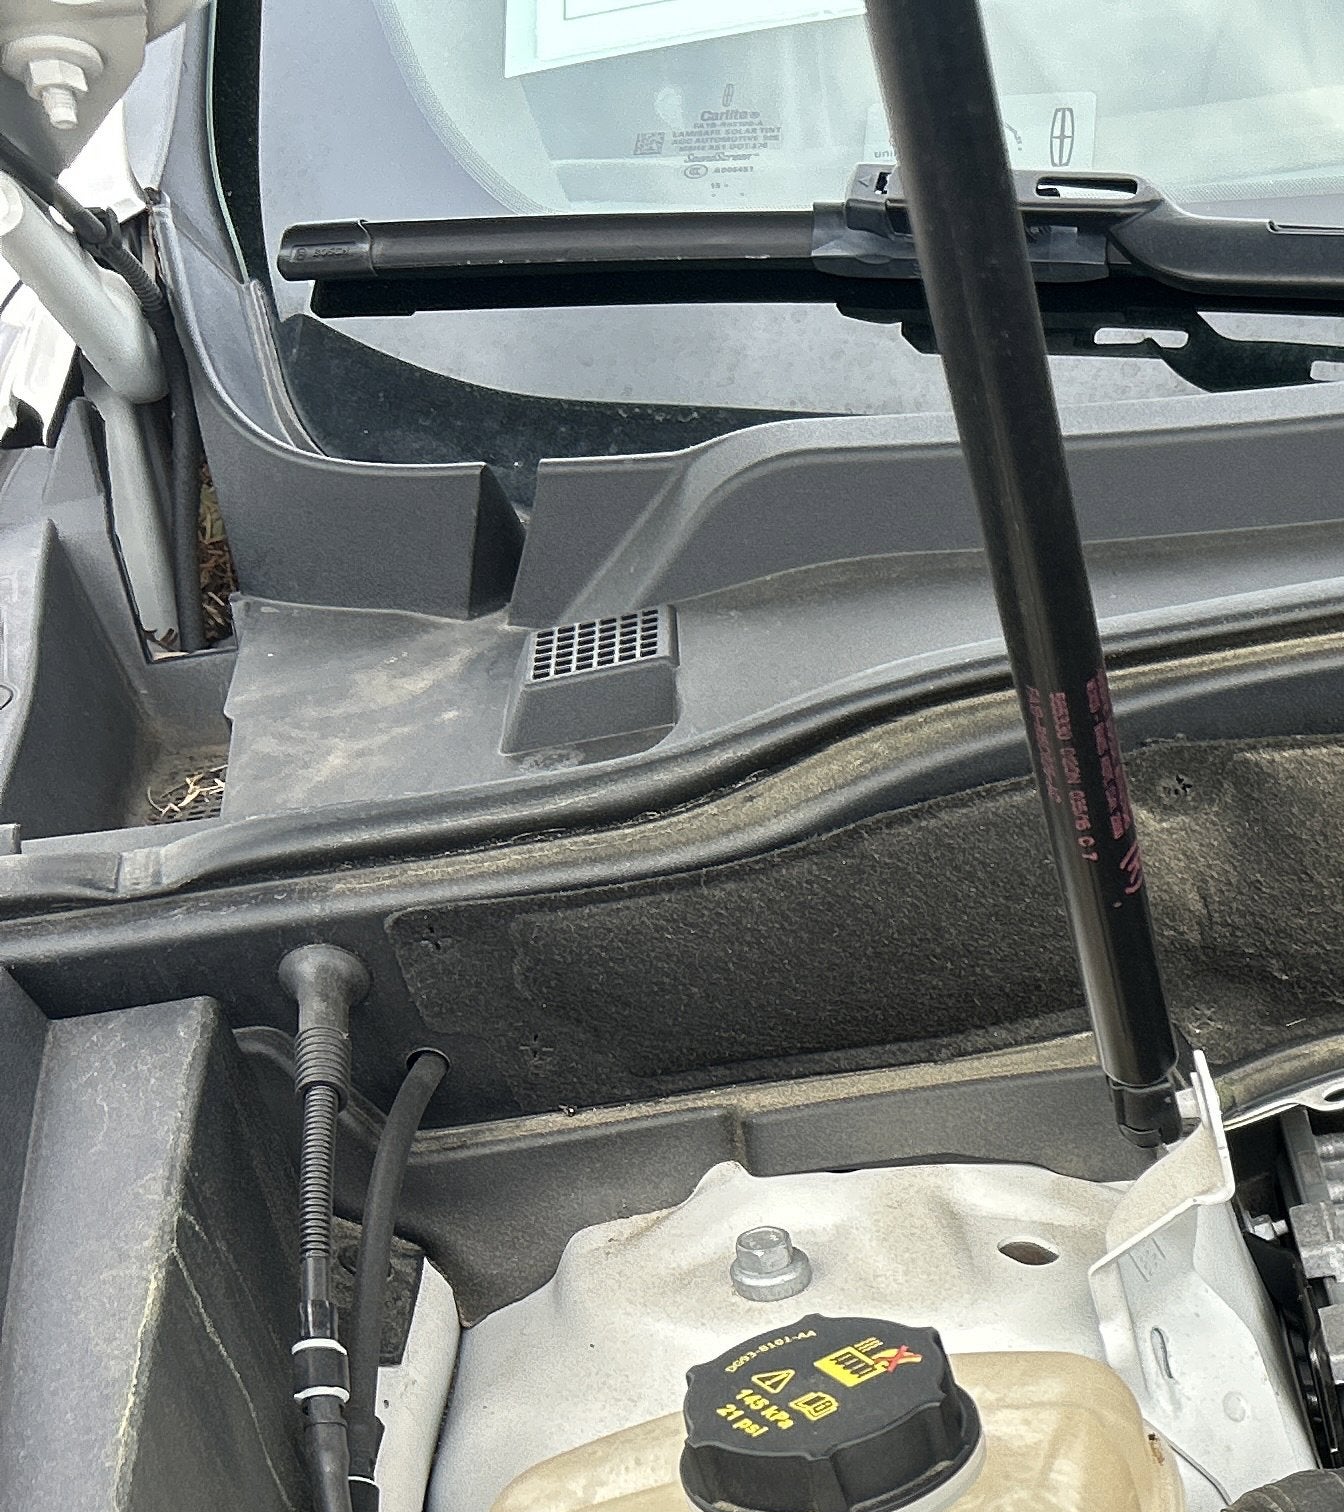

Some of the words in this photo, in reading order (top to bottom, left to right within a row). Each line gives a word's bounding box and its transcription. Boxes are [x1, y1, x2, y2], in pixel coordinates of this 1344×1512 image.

[724, 127, 757, 136] SOLAR
[760, 126, 782, 134] TINT
[736, 1389, 770, 1410] 145
[716, 1404, 745, 1421] 21
[732, 1418, 769, 1438] psi
